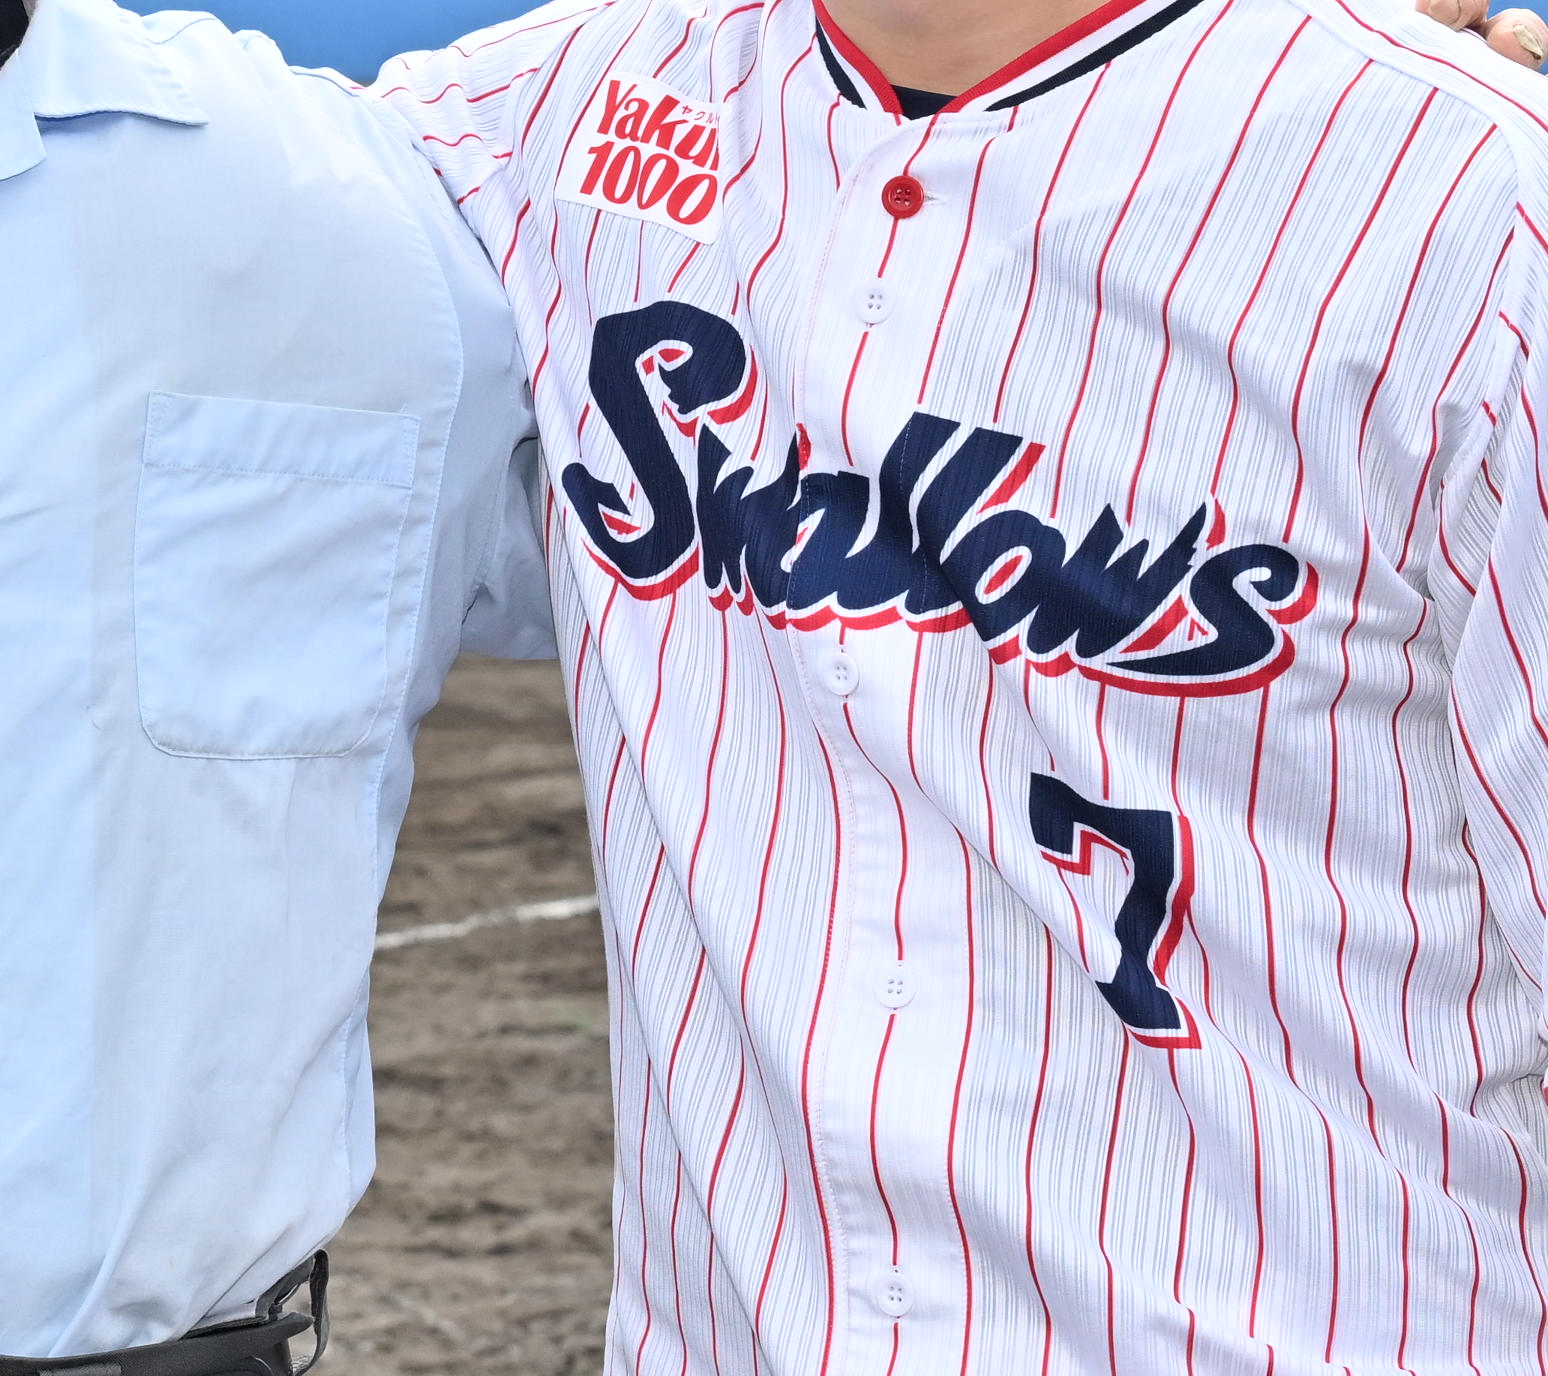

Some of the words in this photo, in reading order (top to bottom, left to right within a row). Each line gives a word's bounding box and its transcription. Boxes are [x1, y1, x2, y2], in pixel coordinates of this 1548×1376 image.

[579, 140, 718, 225] 1000
[560, 299, 1318, 698] Swallows
[1029, 772, 1202, 1050] 7
